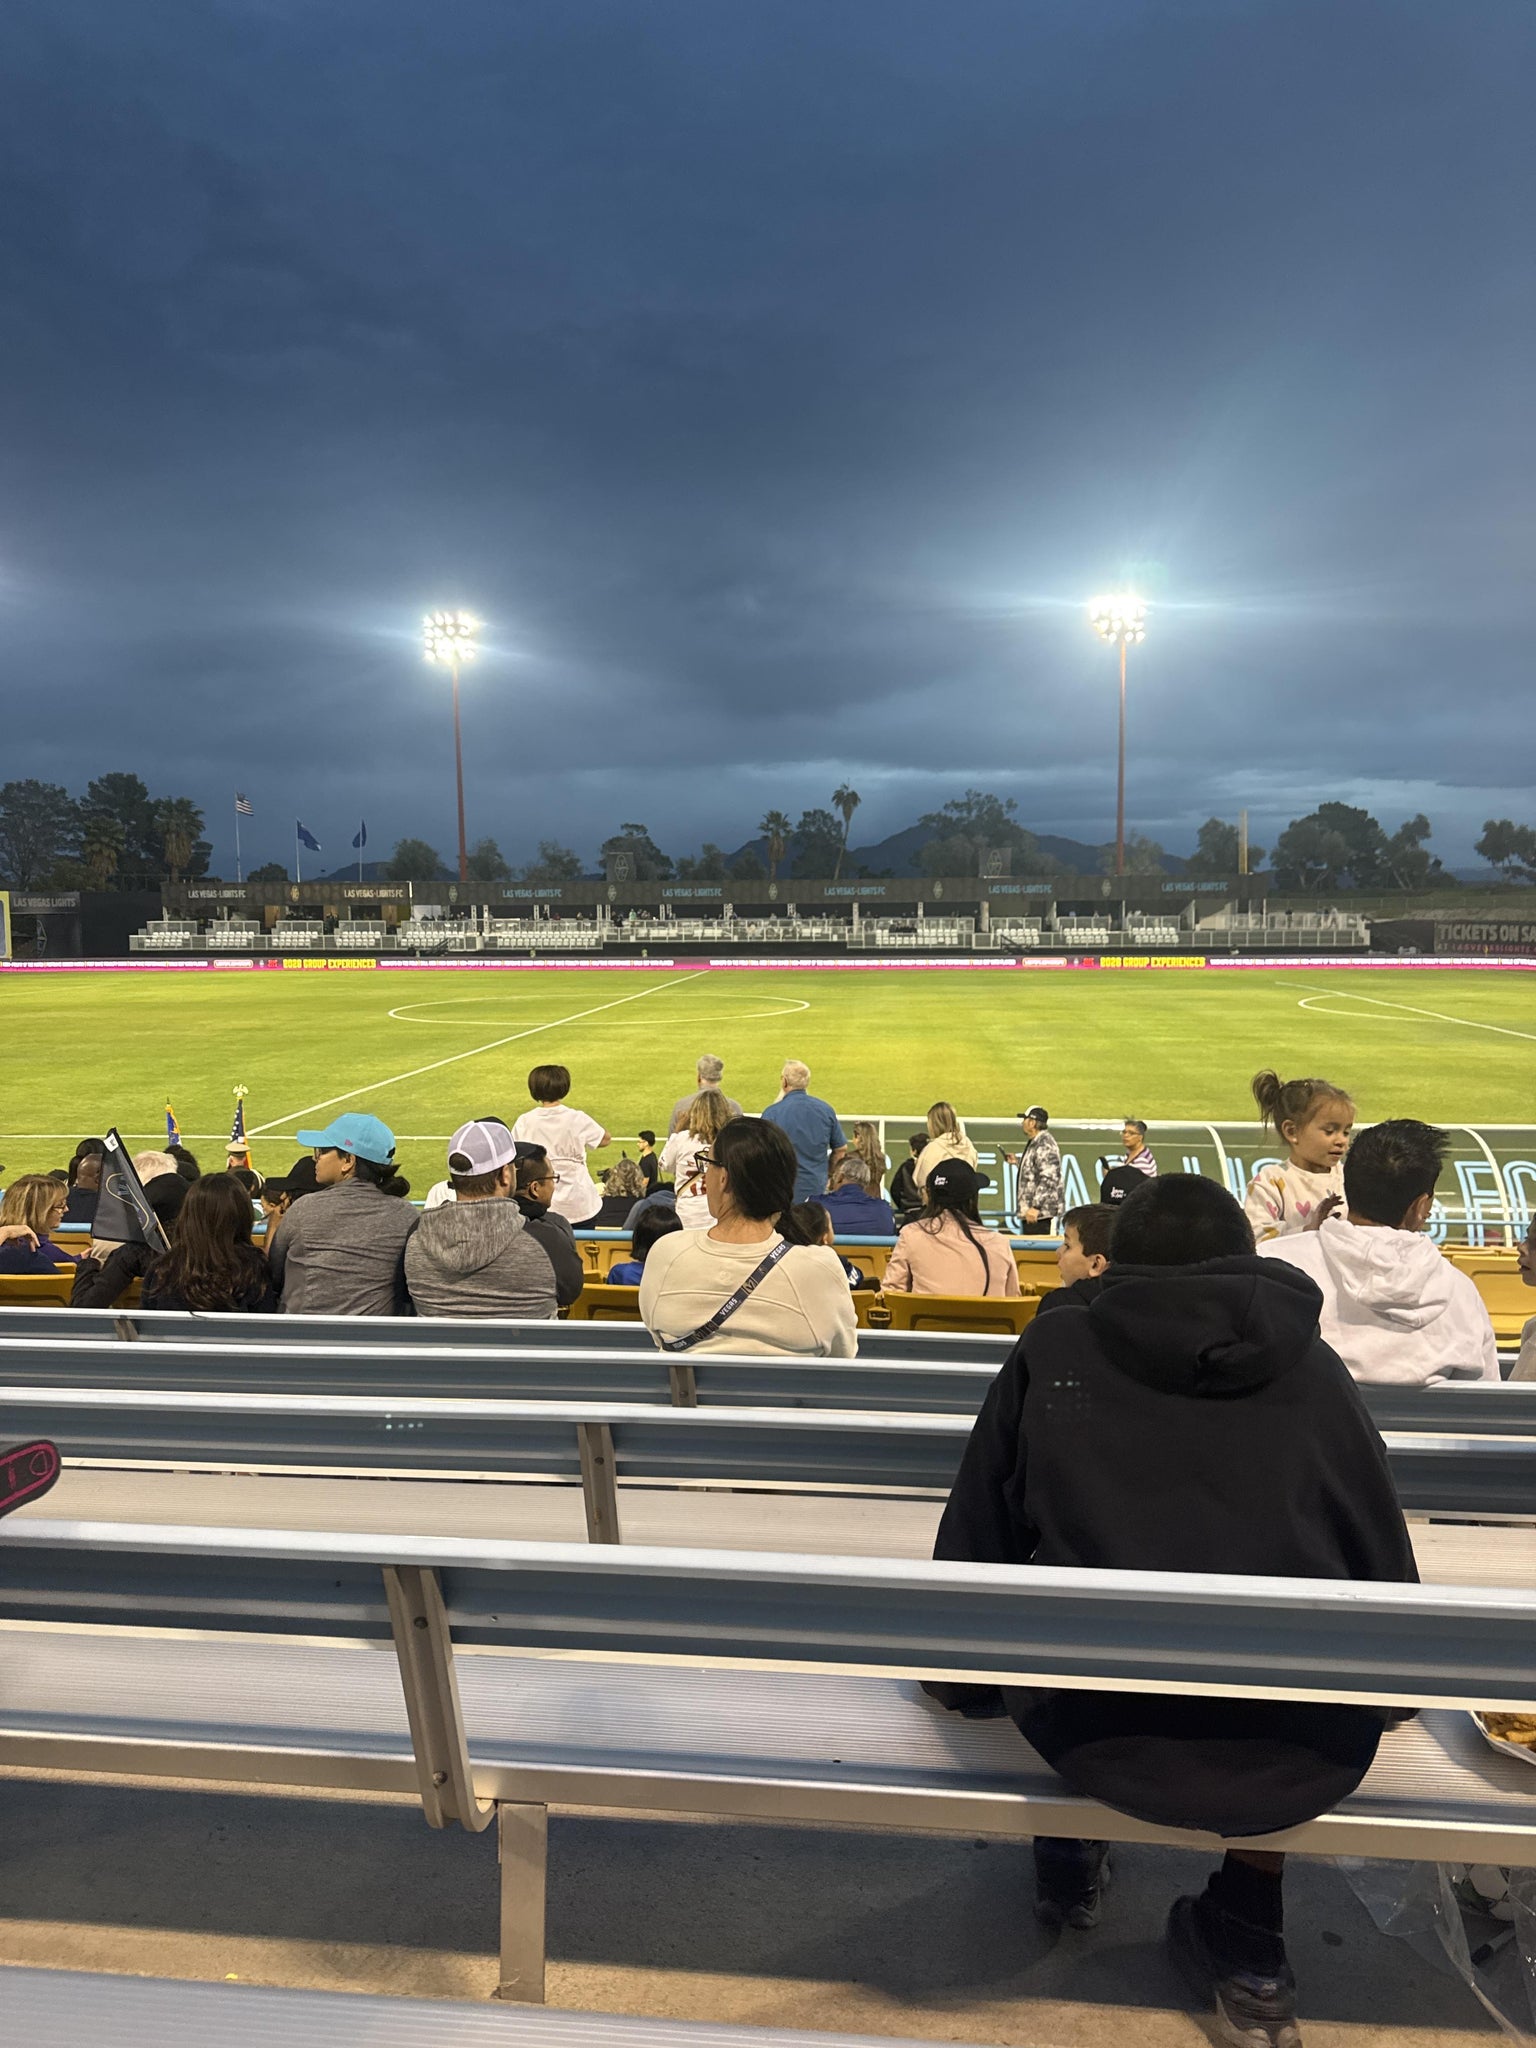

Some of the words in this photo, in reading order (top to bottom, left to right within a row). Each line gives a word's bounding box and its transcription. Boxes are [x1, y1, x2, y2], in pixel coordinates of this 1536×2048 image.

[188, 890, 199, 898] LAS
[200, 890, 217, 898] VEGAS
[239, 890, 246, 898] FC
[344, 889, 355, 898] LAS
[356, 889, 374, 898] VEGAS
[396, 889, 404, 898] FC
[502, 889, 514, 897] LAS
[662, 888, 673, 896] LAS
[13, 898, 27, 907] LAS
[28, 898, 50, 907] VEGAS
[52, 898, 76, 907] LIGHTS
[1438, 924, 1498, 941] TICKETS
[1500, 925, 1520, 942] ON
[303, 959, 326, 968] GROUP
[328, 959, 376, 968] EXPERIENCES
[1123, 957, 1150, 967] GROUP
[1151, 957, 1205, 967] EXPERIENCES
[719, 1297, 738, 1316] VEGAS
